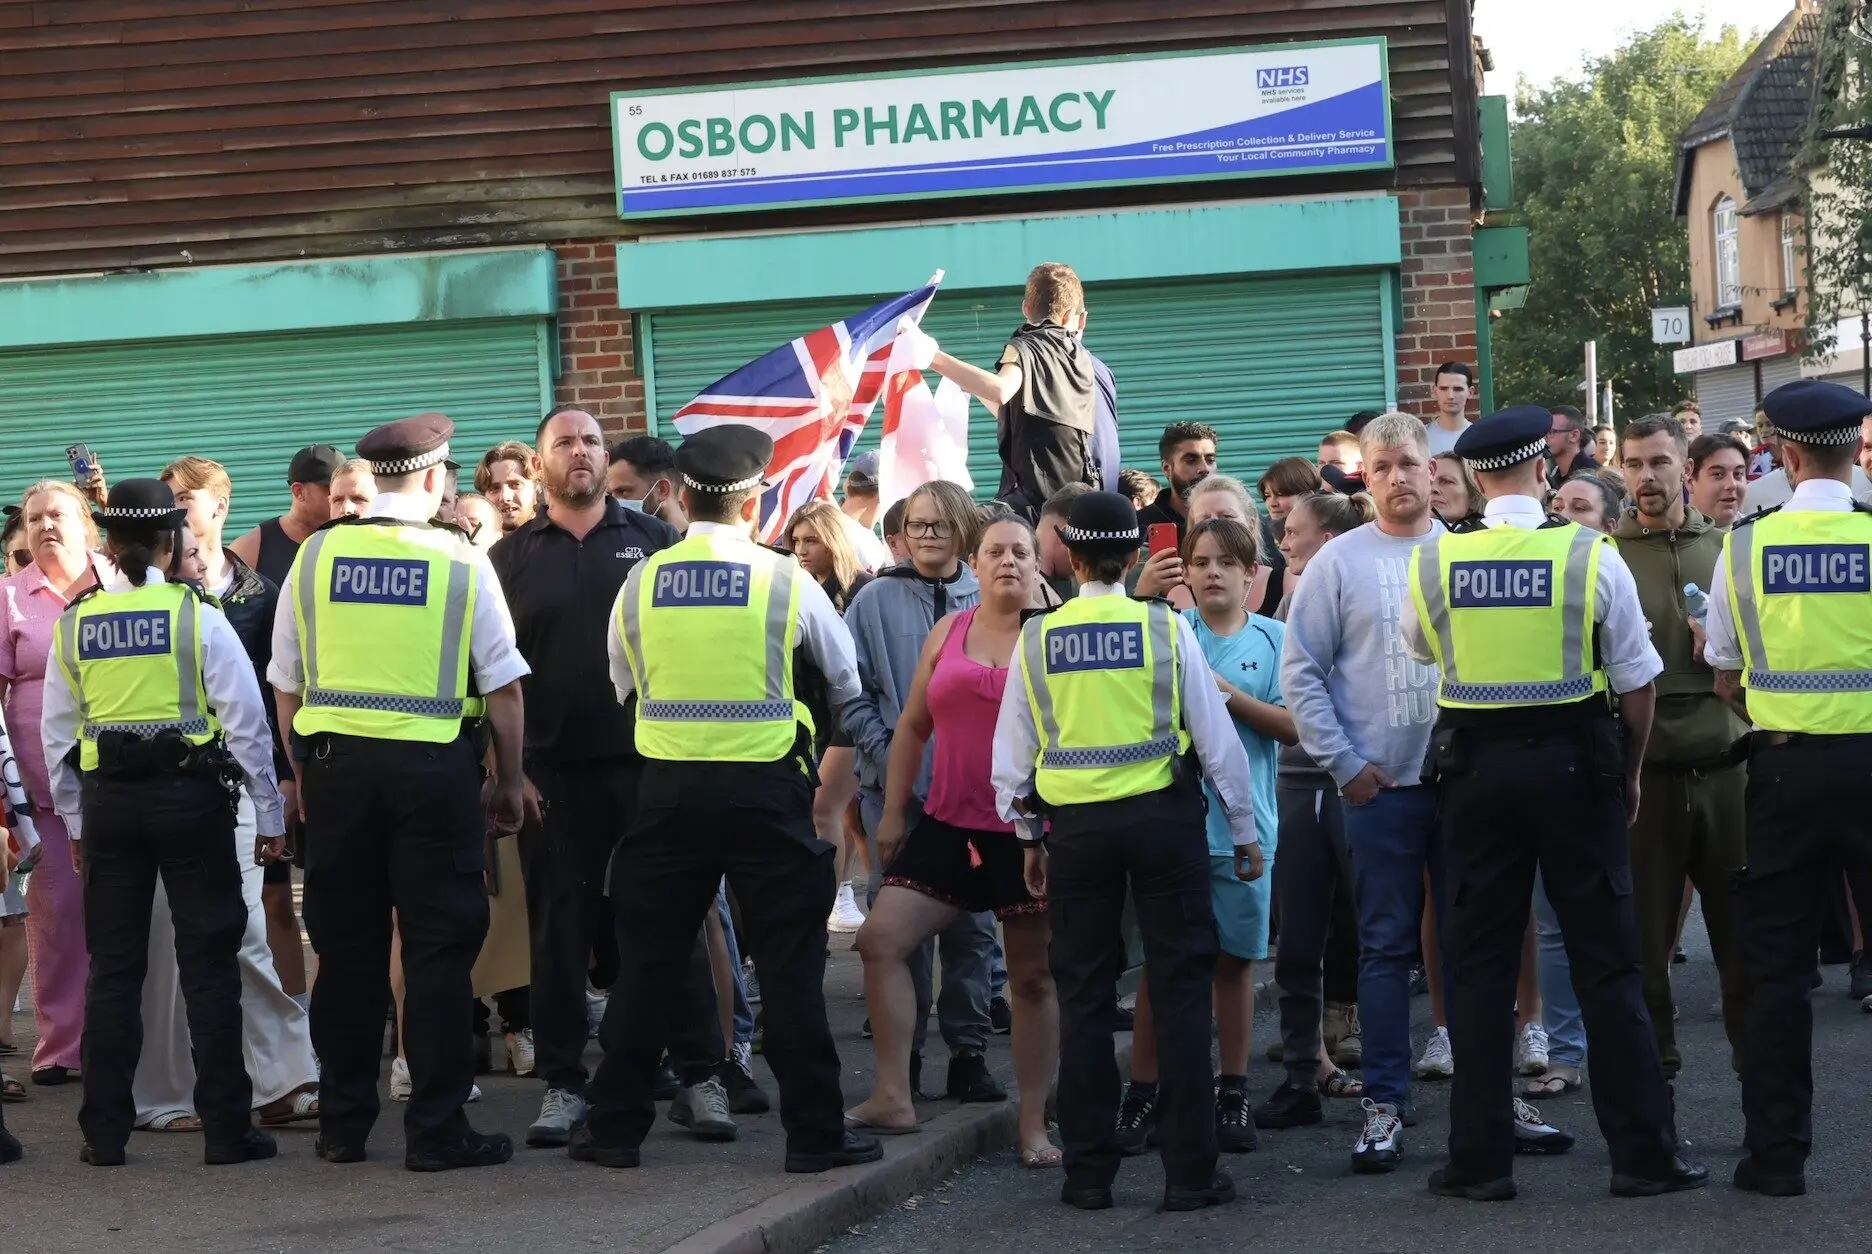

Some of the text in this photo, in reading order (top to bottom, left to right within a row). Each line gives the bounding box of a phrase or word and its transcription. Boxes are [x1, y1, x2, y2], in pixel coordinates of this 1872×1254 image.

[1258, 67, 1307, 88] NHS
[628, 105, 643, 116] 55
[637, 89, 1116, 161] OSBON PHARMACY
[1152, 128, 1375, 152] Free Prescription Collection & Delivery Service
[1216, 144, 1376, 162] Your Local Community Pharmacy
[640, 167, 757, 184] TEL & FAX 01689 837 575
[1660, 317, 1683, 336] 70
[335, 564, 424, 597] POLICE
[657, 568, 745, 599] POLICE
[1454, 568, 1547, 599] POLICE
[1767, 552, 1865, 585] POLICE
[82, 617, 165, 652] POLICE
[1049, 630, 1138, 666] POLICE
